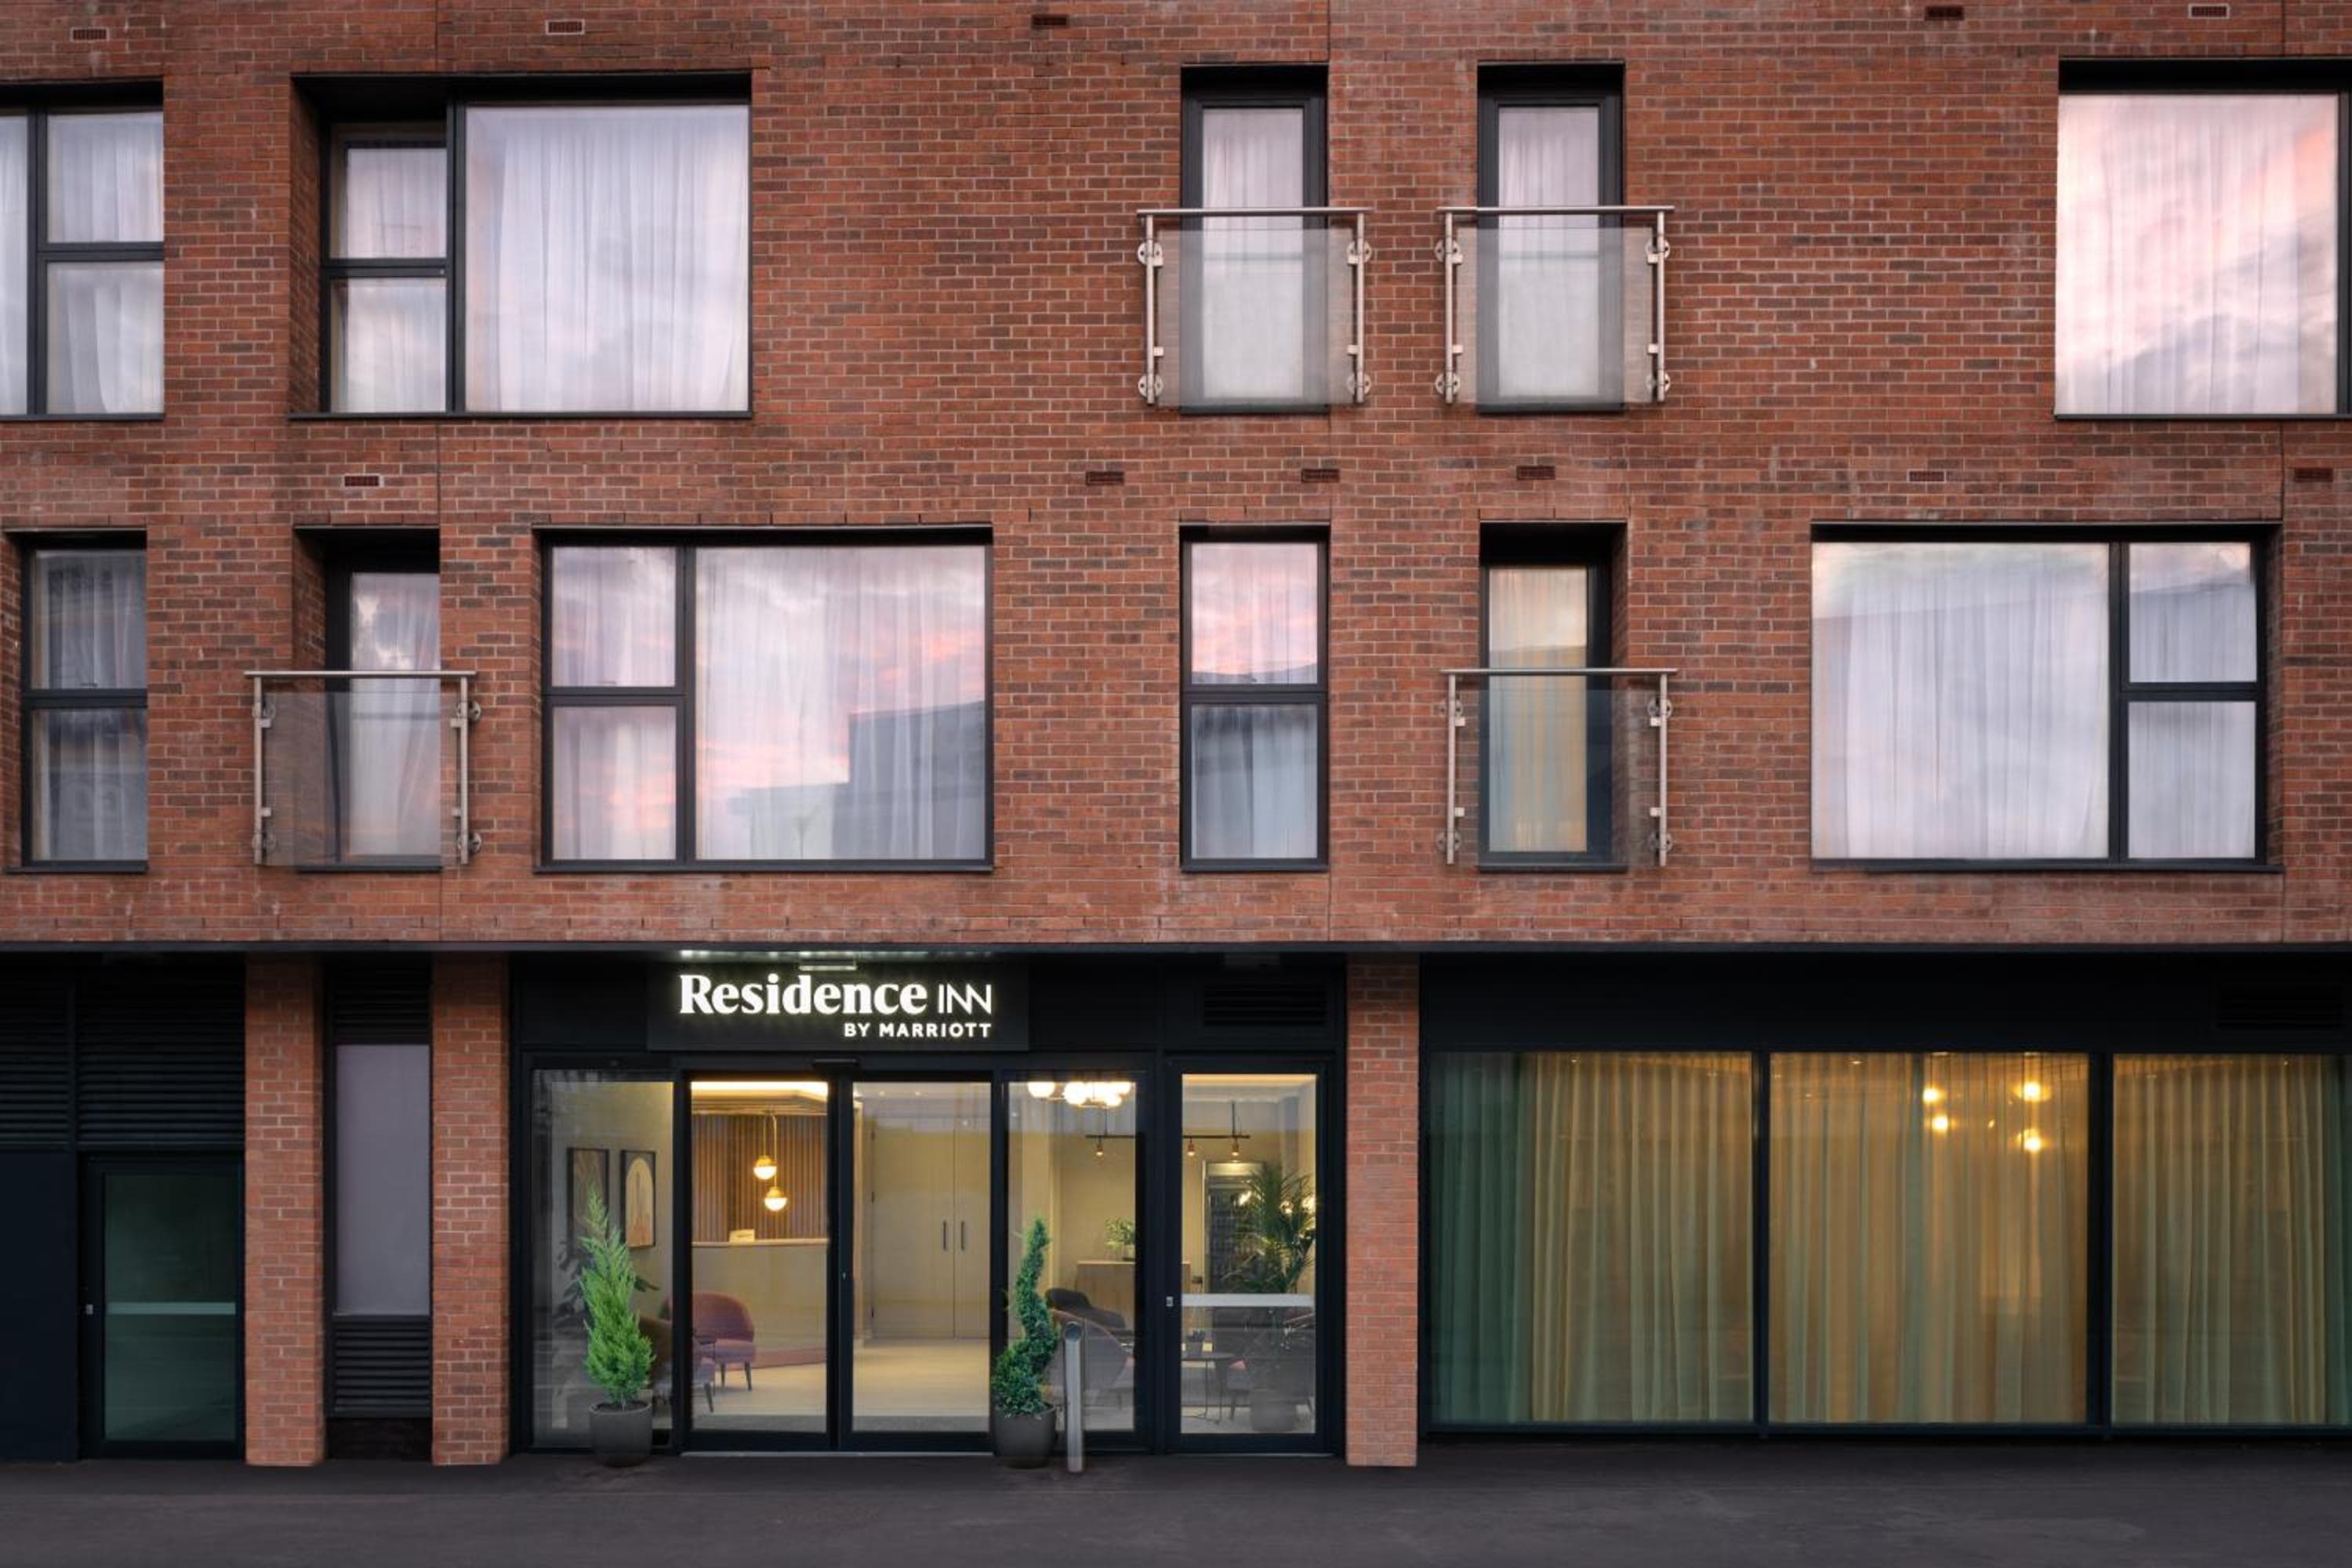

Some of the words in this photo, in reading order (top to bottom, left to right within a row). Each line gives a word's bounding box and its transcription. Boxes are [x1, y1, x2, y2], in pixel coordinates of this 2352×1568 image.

[679, 973, 928, 1015] Residence
[937, 983, 993, 1014] INN
[844, 1022, 871, 1038] BY
[878, 1022, 993, 1038] MARRIOTT
